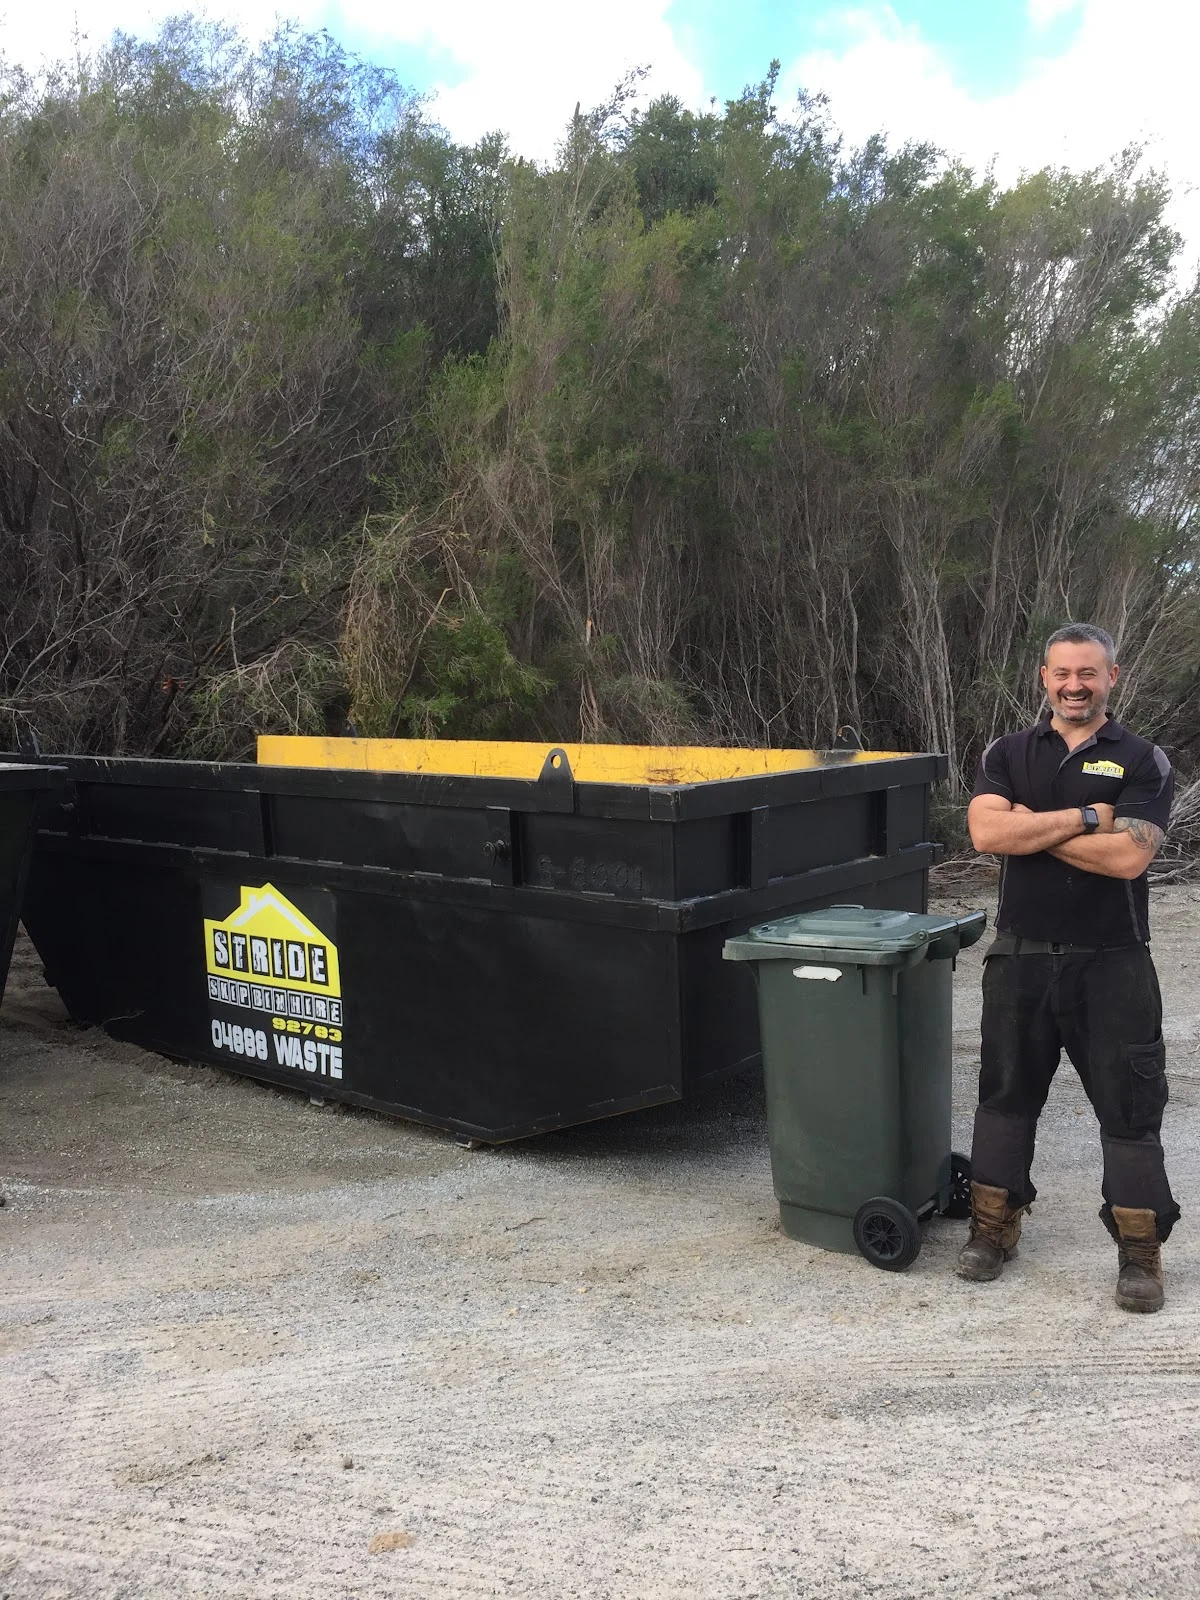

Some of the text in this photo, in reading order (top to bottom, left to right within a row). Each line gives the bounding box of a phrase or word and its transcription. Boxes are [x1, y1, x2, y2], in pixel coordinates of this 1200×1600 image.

[213, 931, 327, 983] STRIDE
[209, 978, 340, 1022] SKIP BIN HIRE
[211, 1019, 343, 1079] 04888 WASTE
[272, 1017, 342, 1042] 92783
